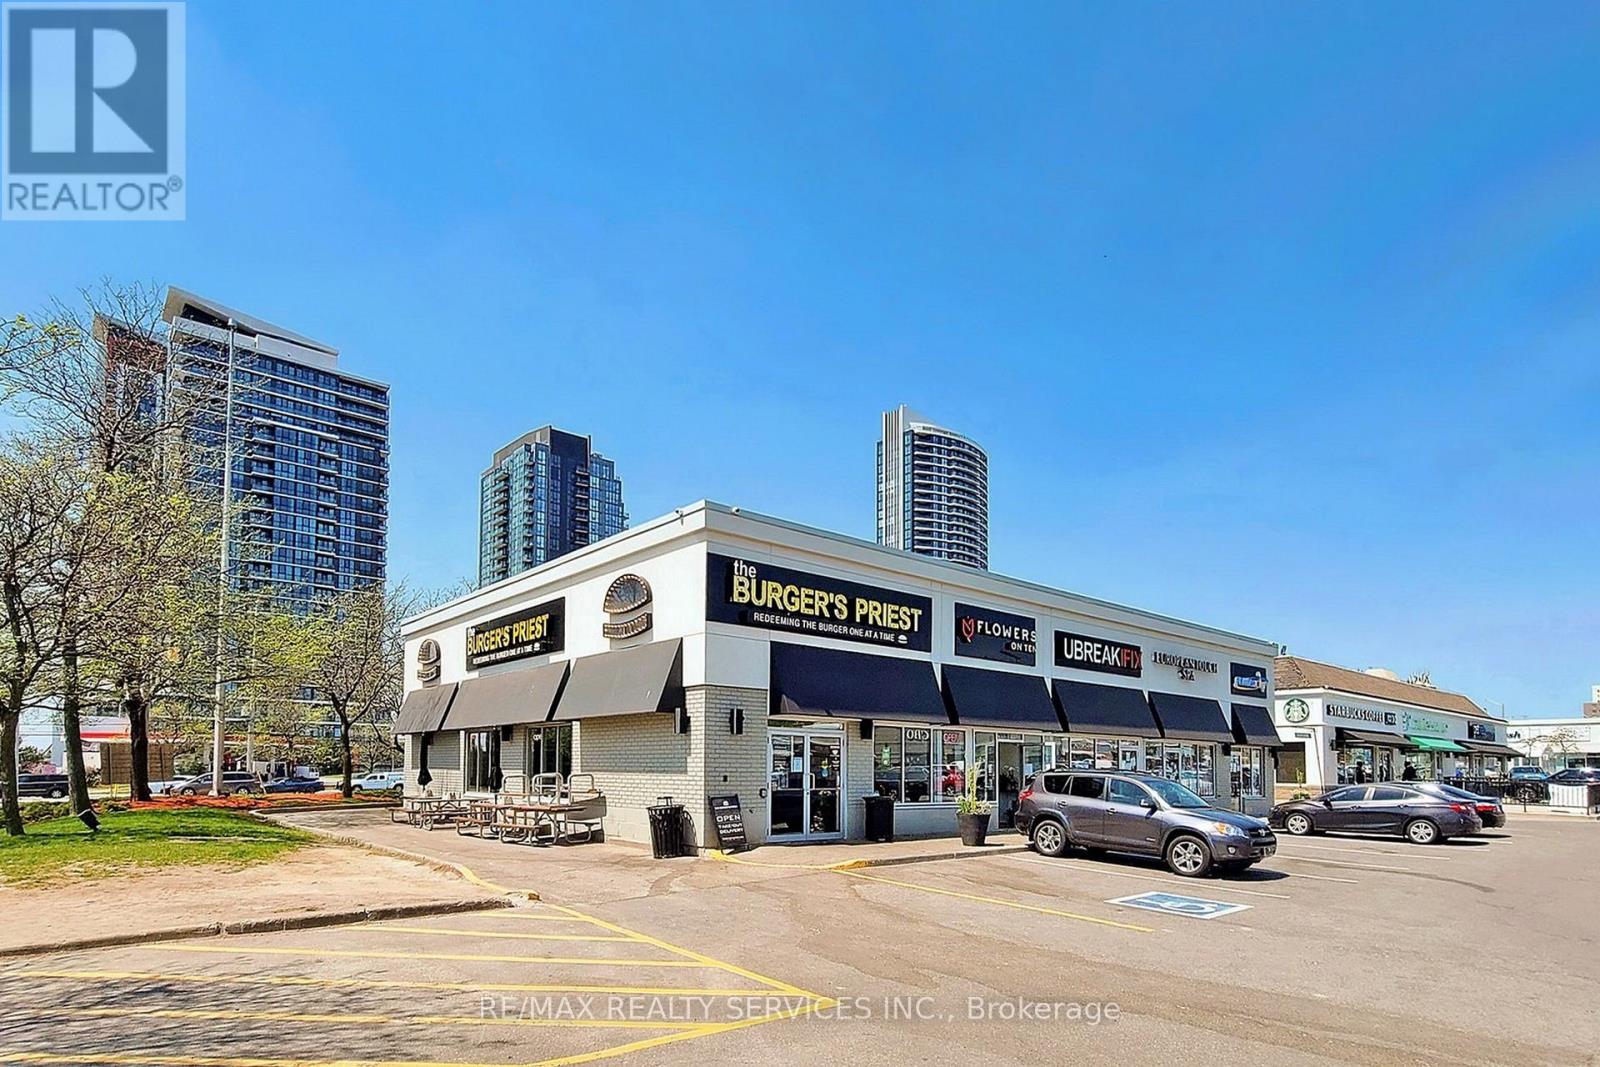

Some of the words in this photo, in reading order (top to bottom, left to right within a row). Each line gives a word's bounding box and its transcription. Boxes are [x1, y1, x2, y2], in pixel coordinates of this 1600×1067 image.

[733, 560, 757, 578] the
[732, 575, 848, 620] BURGER'S
[855, 597, 922, 632] PRIEST
[467, 625, 511, 656] BURGER'S
[512, 614, 549, 644] PRIEST
[753, 612, 801, 628] REDEEMING
[802, 619, 817, 630] THE
[818, 622, 849, 635] BURGER
[849, 627, 864, 637] ONE
[864, 630, 873, 638] AT
[873, 631, 879, 639] A
[879, 631, 896, 642] TIME
[976, 620, 1037, 643] FLOWERS
[1010, 641, 1023, 652] ON
[716, 814, 740, 822] OPEN
